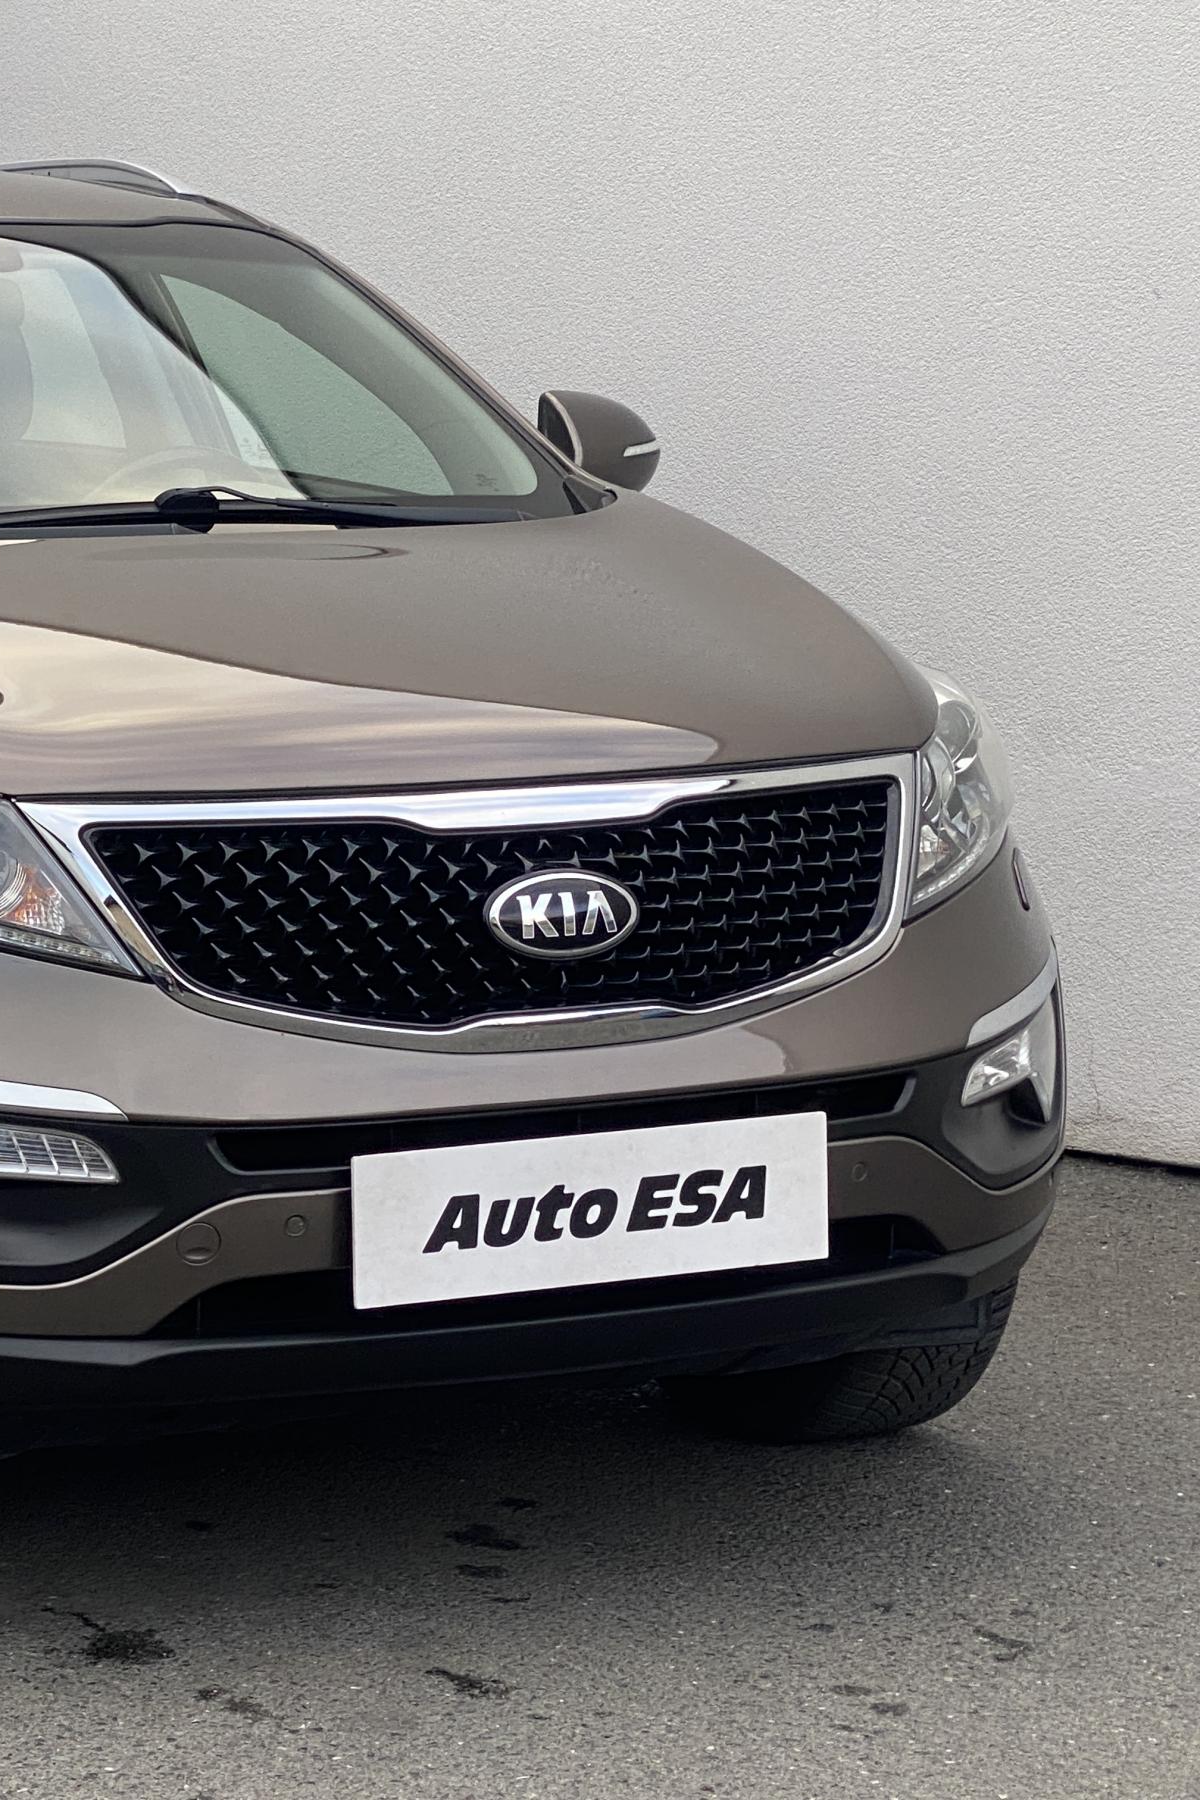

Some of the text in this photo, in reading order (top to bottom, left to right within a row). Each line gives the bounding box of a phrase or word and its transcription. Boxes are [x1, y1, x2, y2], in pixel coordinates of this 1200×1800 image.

[516, 890, 618, 940] KIA
[422, 1165, 767, 1254] Auto ESA
